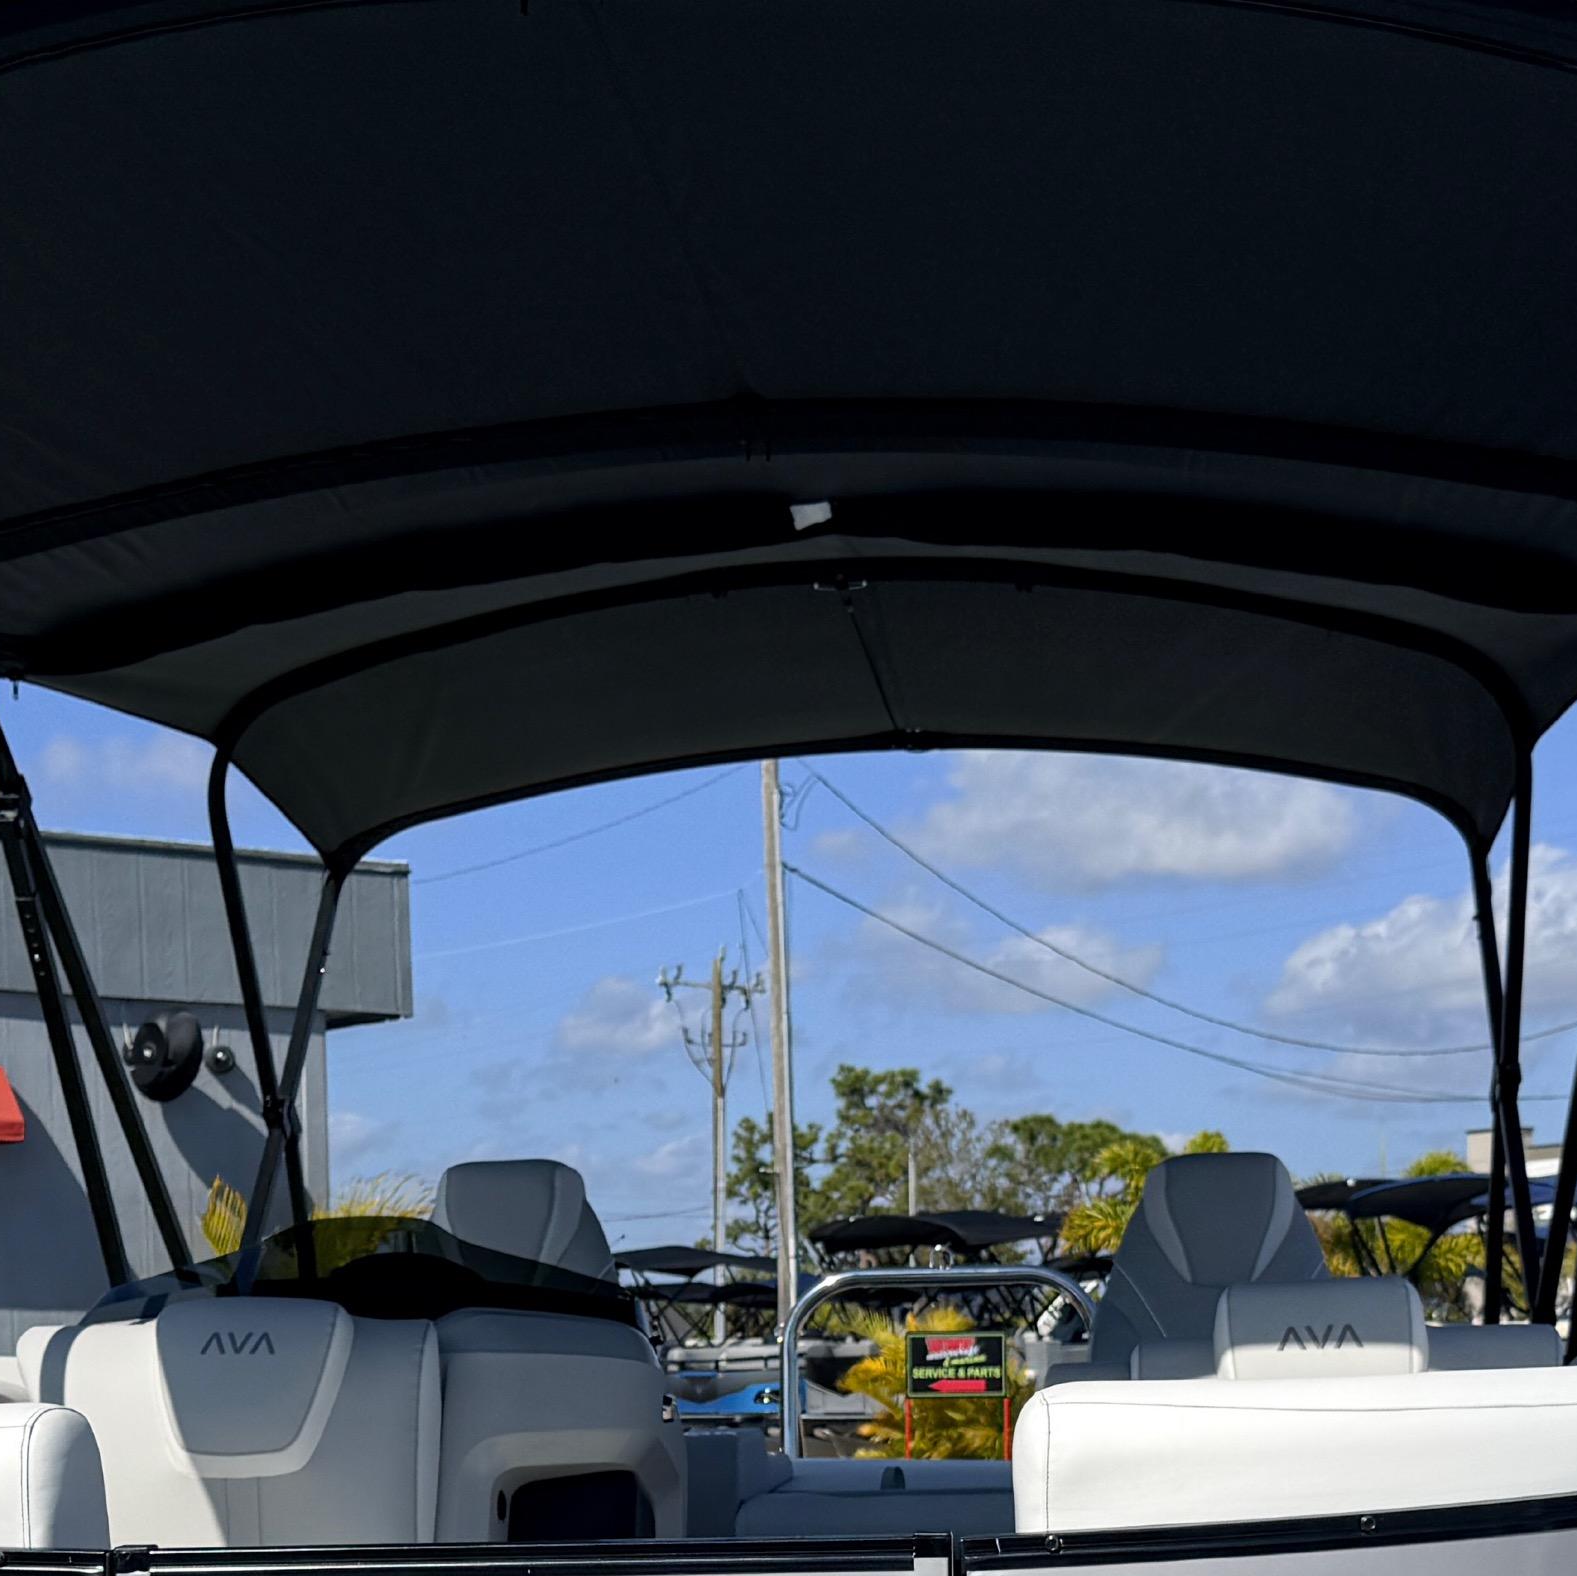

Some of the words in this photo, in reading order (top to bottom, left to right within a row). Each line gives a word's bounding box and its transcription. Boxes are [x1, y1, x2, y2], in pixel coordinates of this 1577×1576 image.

[200, 1331, 275, 1355] AVA
[1277, 1324, 1364, 1351] AVA
[912, 1366, 956, 1379] SERVICE
[967, 1366, 1001, 1379] PARTS
